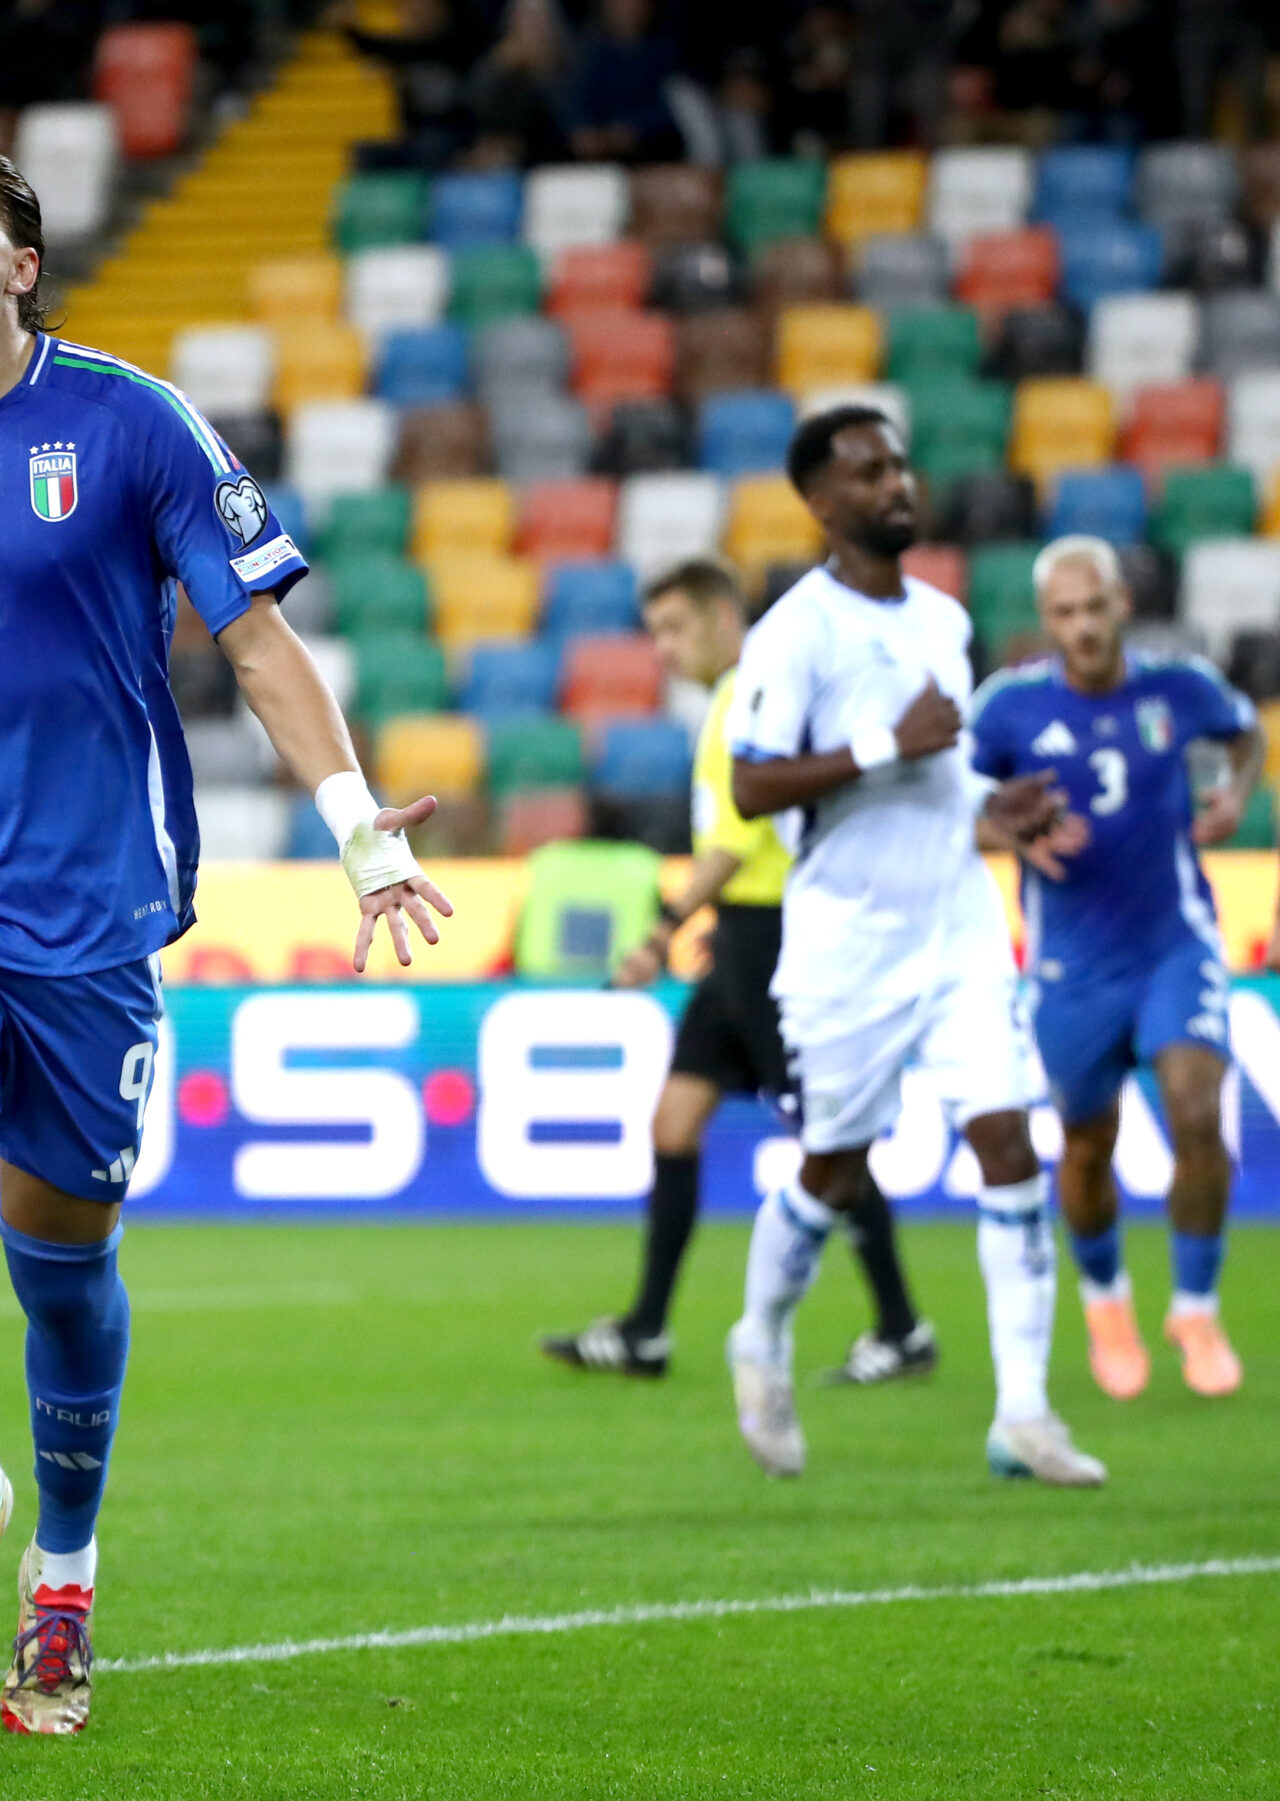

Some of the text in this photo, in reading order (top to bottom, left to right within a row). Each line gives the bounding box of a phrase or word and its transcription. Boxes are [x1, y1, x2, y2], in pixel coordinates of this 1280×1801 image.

[32, 457, 73, 474] ITALIA
[1087, 746, 1129, 818] 3
[119, 1041, 154, 1131] 9
[35, 1396, 111, 1428] ITALIA
